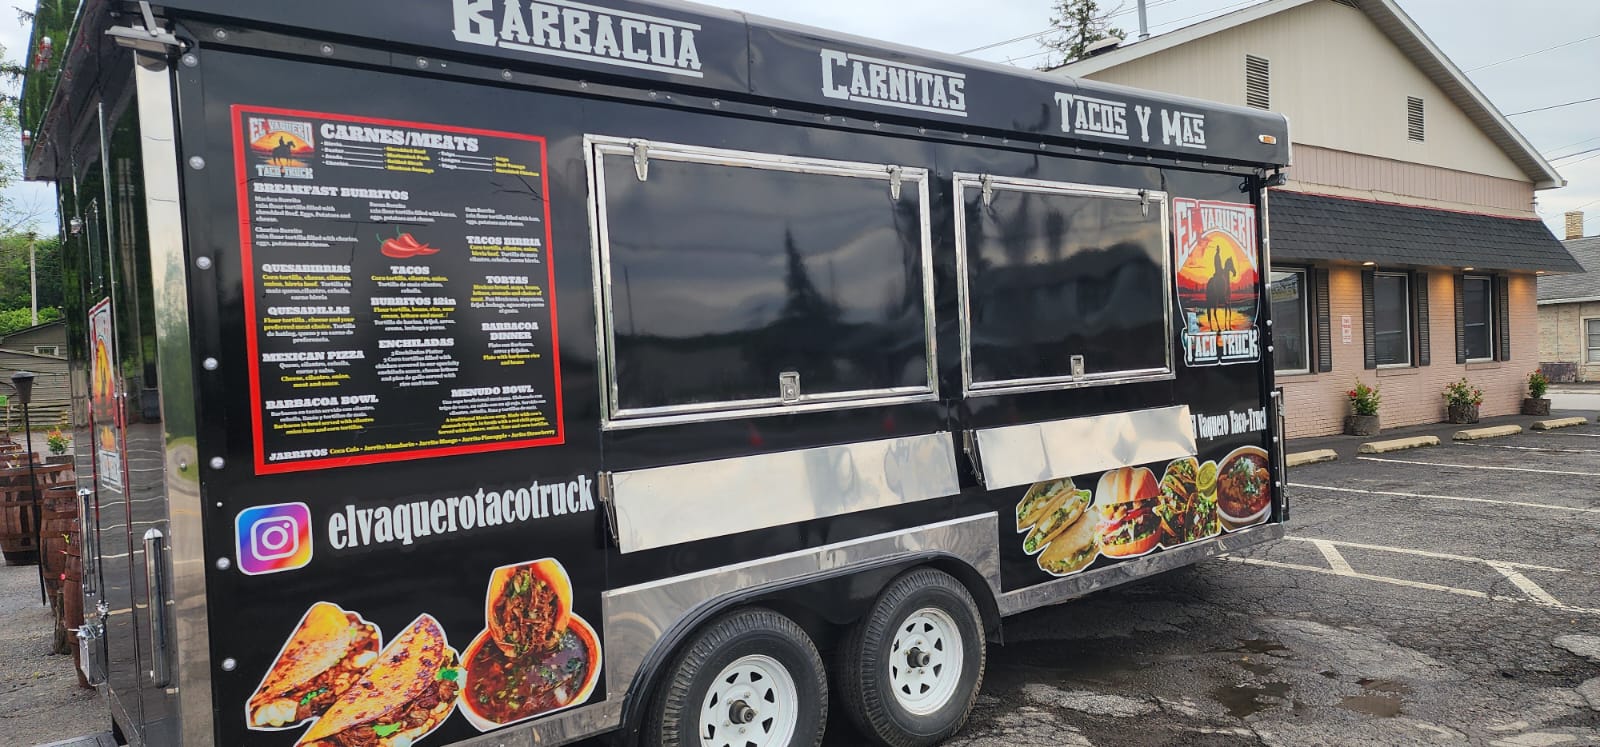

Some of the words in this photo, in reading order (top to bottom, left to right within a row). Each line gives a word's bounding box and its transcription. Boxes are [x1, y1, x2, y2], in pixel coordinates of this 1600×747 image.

[451, 0, 702, 70] BARBACOA
[820, 48, 966, 110] CARNITAS
[1054, 91, 1128, 136] TACOS
[1135, 104, 1151, 143] Y
[1161, 109, 1207, 148] MAS
[249, 117, 267, 144] EL
[320, 123, 479, 152] CARNES/MEATS
[253, 182, 339, 197] BREAKFAST
[340, 187, 409, 200] BURRITOS
[466, 235, 502, 245] TACOS
[503, 237, 541, 246] BIRRIA
[1175, 201, 1198, 272] EL
[1200, 204, 1258, 273] VAQUERO
[262, 264, 351, 273] QUESABIRRIAS
[390, 266, 430, 274] TACOS
[485, 276, 528, 284] TORTAS
[370, 297, 431, 306] BURRITOS
[433, 297, 456, 305] 12in
[268, 306, 350, 315] QUESADILLAS
[481, 322, 539, 331] BARBACOA
[490, 332, 532, 340] DINNER
[378, 338, 454, 348] ENCHILADAS
[1186, 332, 1217, 362] TACO
[1222, 329, 1259, 358] TRUCK
[262, 352, 325, 362] MEXICAN
[327, 350, 365, 360] PIZZA
[451, 387, 500, 397] MENUDO
[502, 385, 534, 394] BOWL
[265, 397, 339, 409] BARBACOA
[341, 394, 379, 405] BOWL
[1197, 413, 1229, 440] Vaquero
[269, 448, 328, 461] JARRITOS
[328, 474, 595, 550] elvaquerotacotruck
